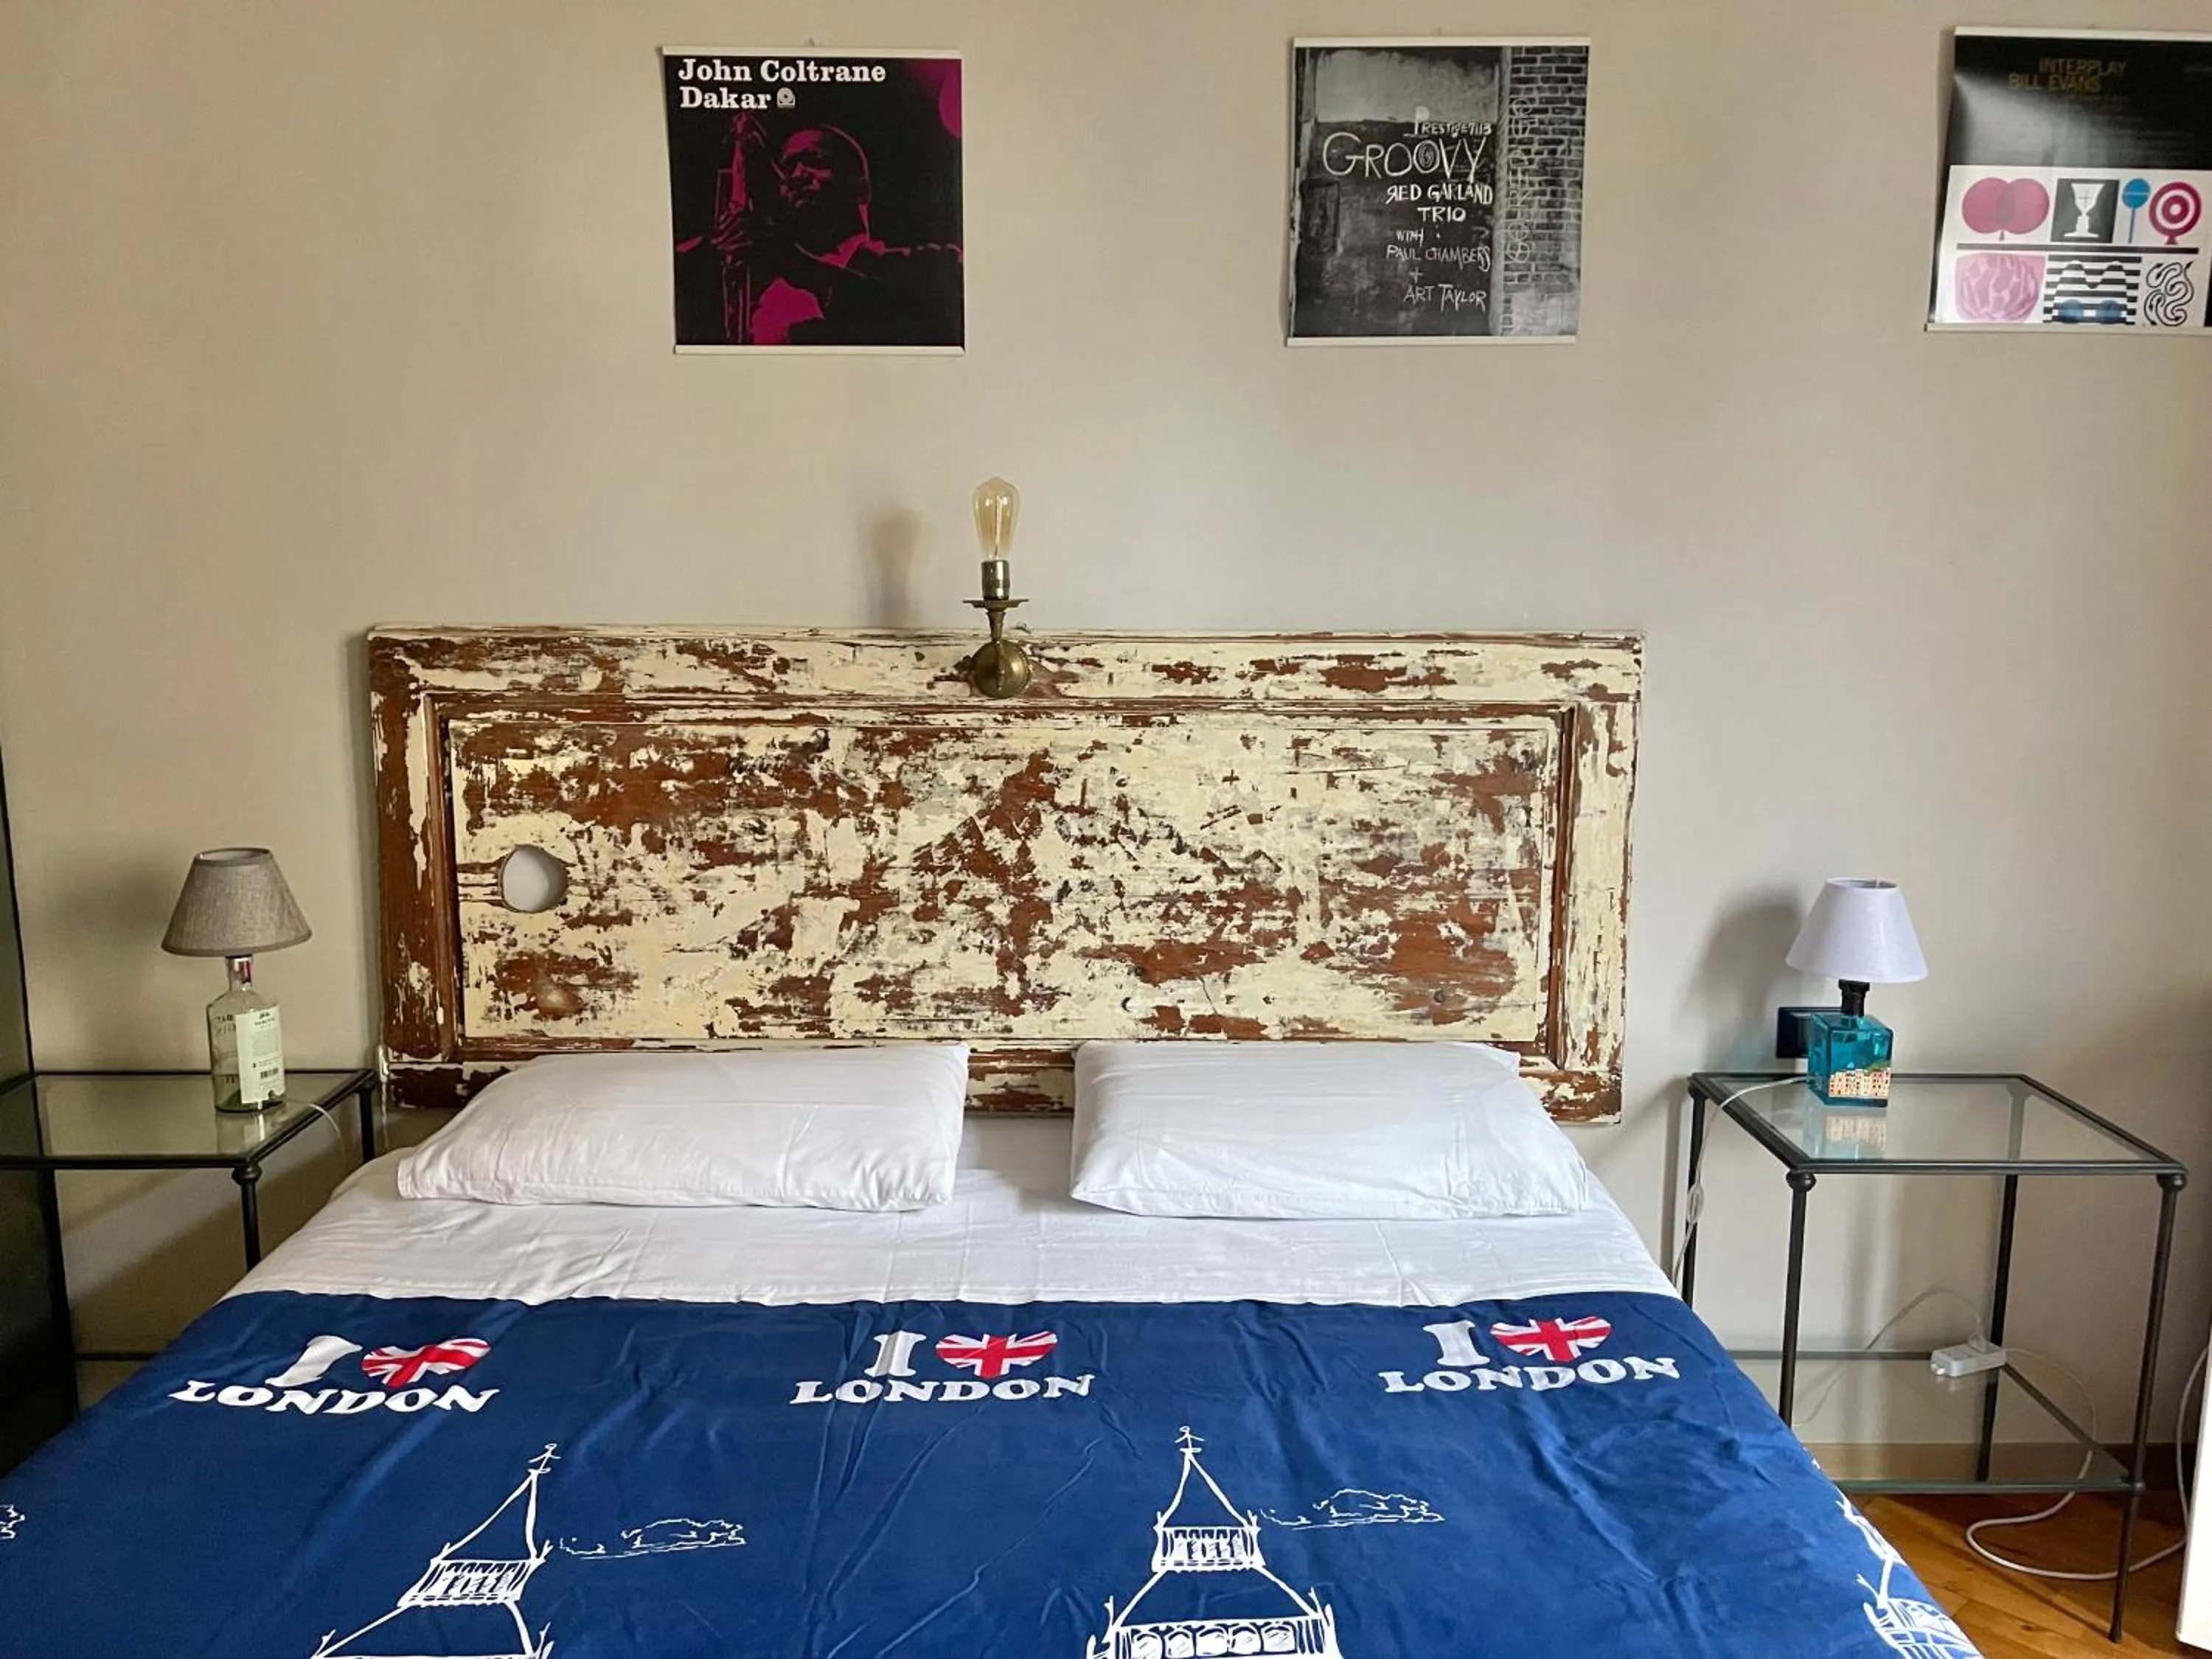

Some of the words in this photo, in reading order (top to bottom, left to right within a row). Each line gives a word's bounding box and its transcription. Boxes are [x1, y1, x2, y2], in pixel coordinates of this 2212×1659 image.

[678, 58, 753, 81] John
[760, 60, 886, 82] Coltrane
[2008, 72, 2041, 89] BILL
[2048, 74, 2101, 92] EVANS
[2039, 58, 2127, 77] INTERPLAY
[679, 86, 771, 109] Dakar
[1323, 131, 1486, 184] GROOVY
[1385, 184, 1422, 204] RED
[1427, 182, 1494, 205] GARLAND
[1416, 206, 1467, 223] TRIO
[1385, 244, 1422, 261] PAUL
[1425, 245, 1491, 272] CHAMBERS
[1403, 284, 1436, 305] ART
[1438, 283, 1486, 313] TAYLOR
[864, 1330, 927, 1377] I
[1422, 1320, 1491, 1366] I
[1377, 1356, 1680, 1393] LONDON
[168, 1380, 500, 1415] LONDON
[790, 1374, 1096, 1405] LONDON
